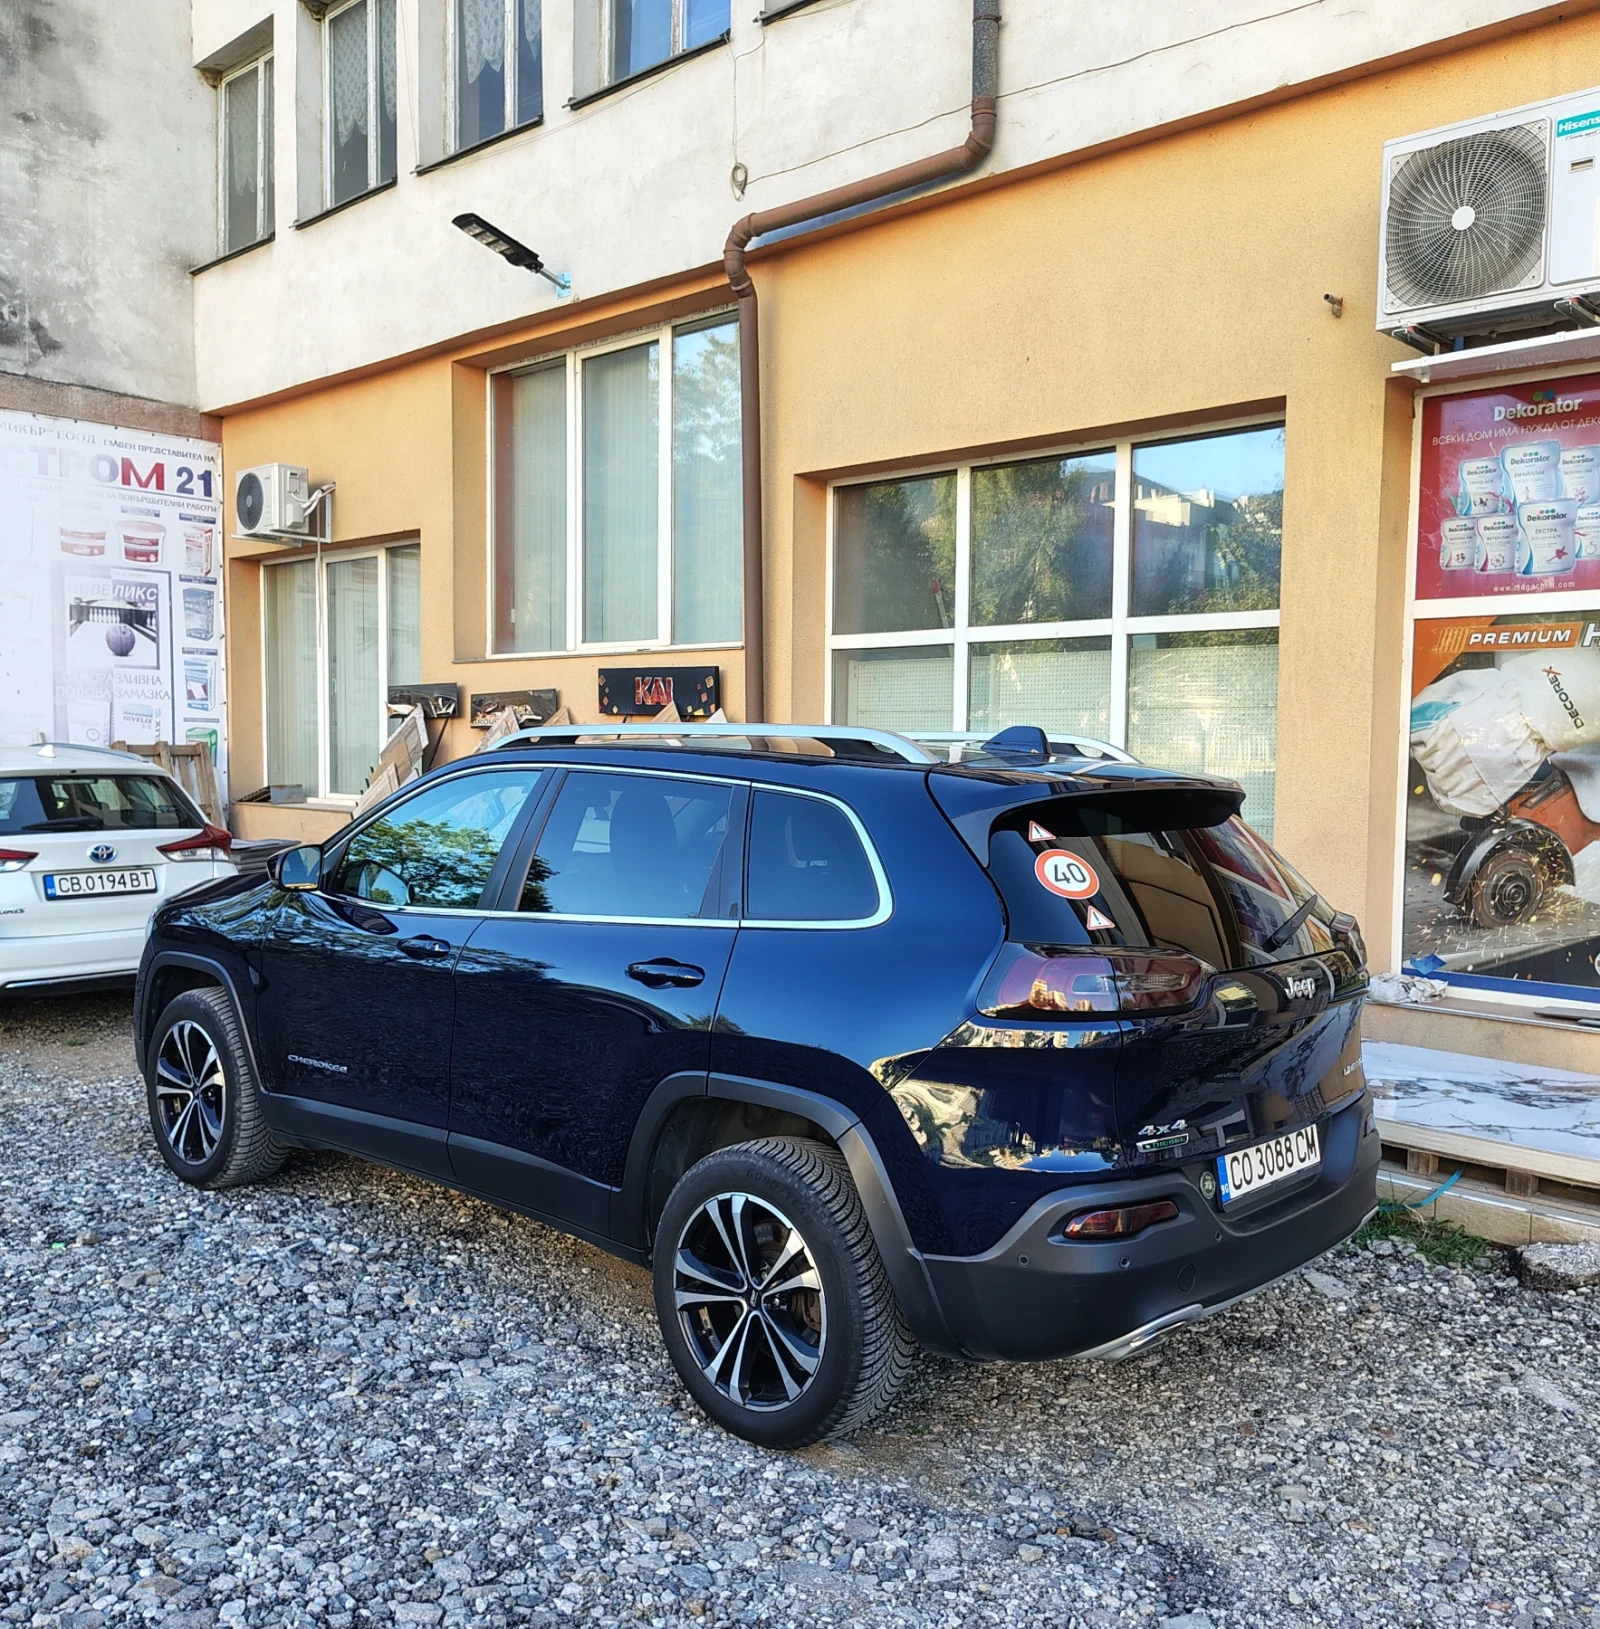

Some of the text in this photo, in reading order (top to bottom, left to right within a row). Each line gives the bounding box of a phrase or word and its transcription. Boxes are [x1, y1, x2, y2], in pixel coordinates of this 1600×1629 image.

[1494, 398, 1582, 421] Dekorator
[1432, 416, 1600, 445] ВСЕКИ ДОМ ИМА НУЖДА ОТ ДЕК
[57, 430, 96, 445] ЕООД
[103, 439, 136, 451] ГЛАВЕН
[138, 444, 203, 461] ПРЕДСТАВИТЕЛ
[204, 455, 215, 463] НА
[1511, 455, 1550, 465] Dekorator
[1562, 457, 1595, 465] Dekorator
[1467, 468, 1497, 476] Dekorator
[176, 466, 212, 498] 21
[119, 492, 185, 508] ДОВЪРШИТЕЛНИ
[186, 501, 217, 513] РАБОТИ
[1527, 513, 1567, 521] Dekorator
[1468, 629, 1572, 645] PREMIUM
[115, 688, 171, 700] ЗАМАЗКА
[635, 677, 673, 705] KAI
[1542, 665, 1585, 729] DECOREX
[472, 718, 497, 726] GROU
[1054, 863, 1086, 883] 40
[1284, 977, 1315, 999] Jeep
[288, 1054, 347, 1073] CHEROKEE
[1138, 1119, 1187, 1136] 4x4
[1153, 1136, 1185, 1148] DIESEL
[1221, 1183, 1230, 1195] BG
